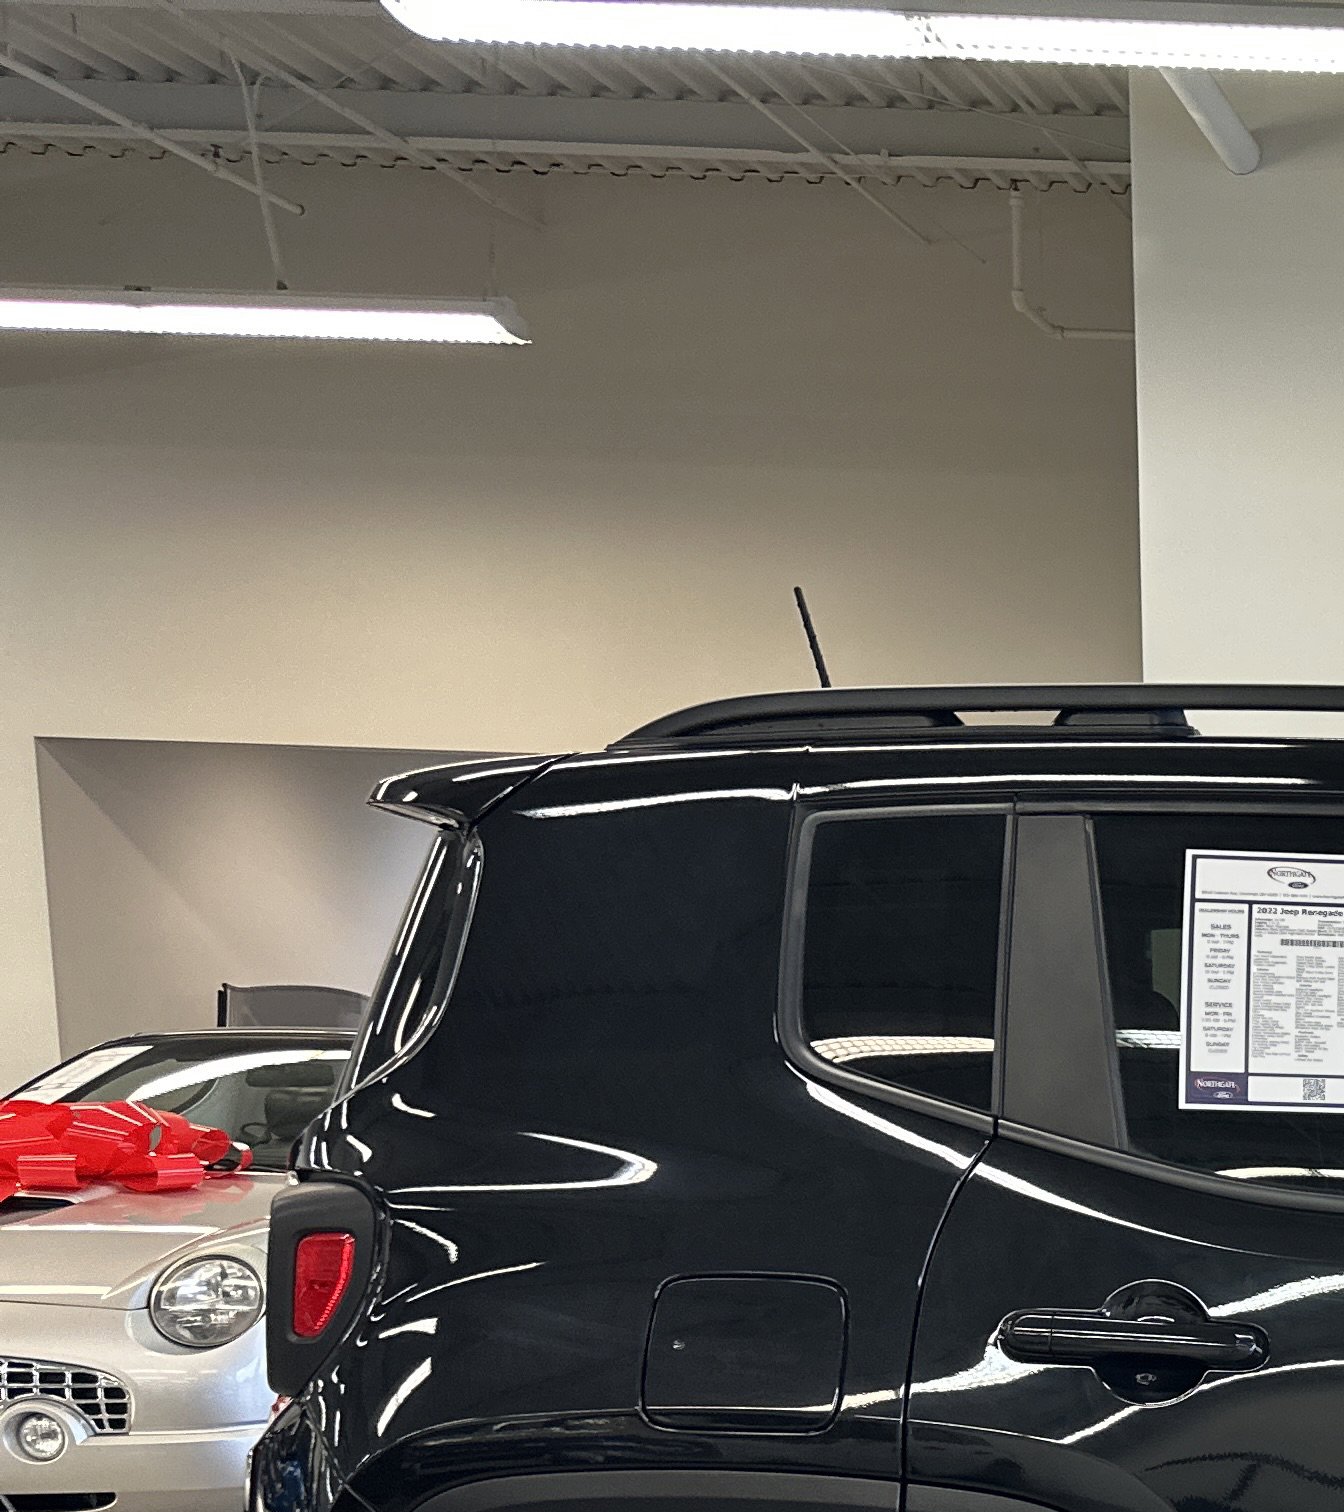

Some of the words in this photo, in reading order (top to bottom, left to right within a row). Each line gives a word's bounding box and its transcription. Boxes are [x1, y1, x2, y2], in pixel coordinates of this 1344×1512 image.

[1256, 907, 1278, 915] 2022
[1279, 908, 1299, 917] Jeep
[1301, 908, 1344, 918] Renegade
